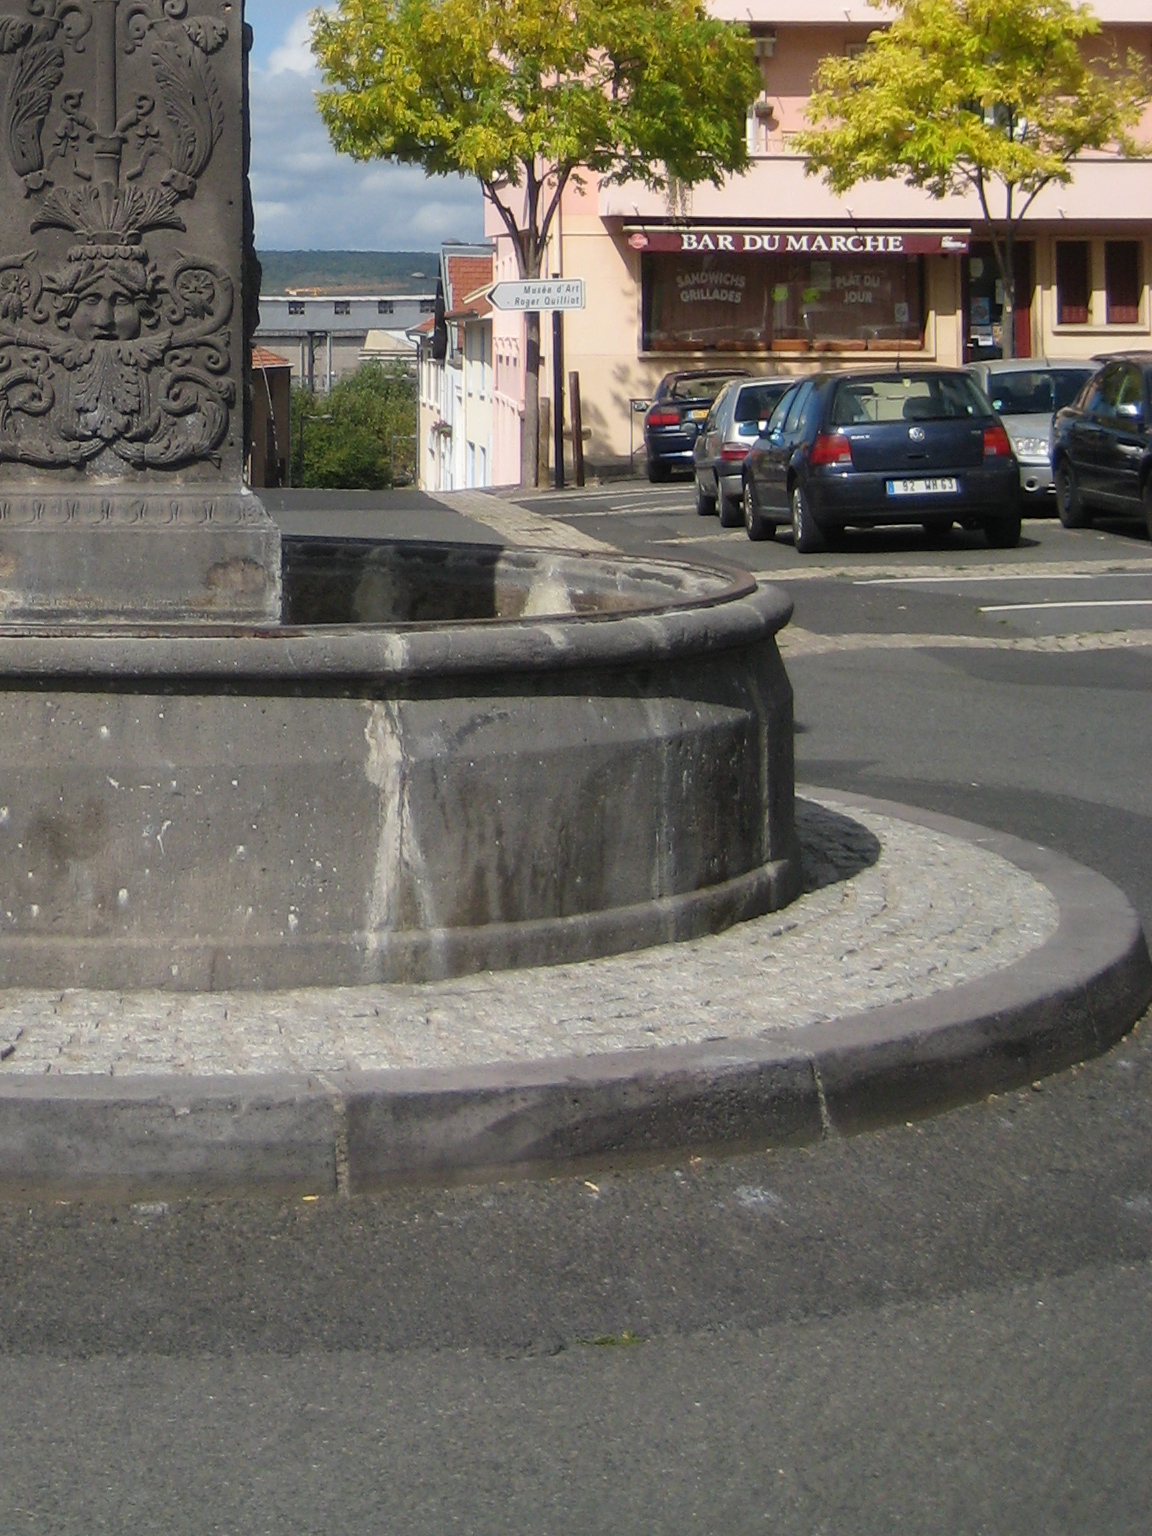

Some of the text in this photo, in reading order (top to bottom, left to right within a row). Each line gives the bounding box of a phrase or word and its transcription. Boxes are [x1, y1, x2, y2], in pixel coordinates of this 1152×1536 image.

[681, 234, 904, 252] BAR DU MARCHE
[676, 271, 746, 288] SANDWICHS
[863, 274, 881, 288] DU
[523, 283, 580, 294] Musée d'Art
[514, 295, 580, 309] Roger Quilliot
[680, 288, 742, 304] GRILLADES
[844, 291, 873, 303] JOUR
[902, 479, 916, 492] 92
